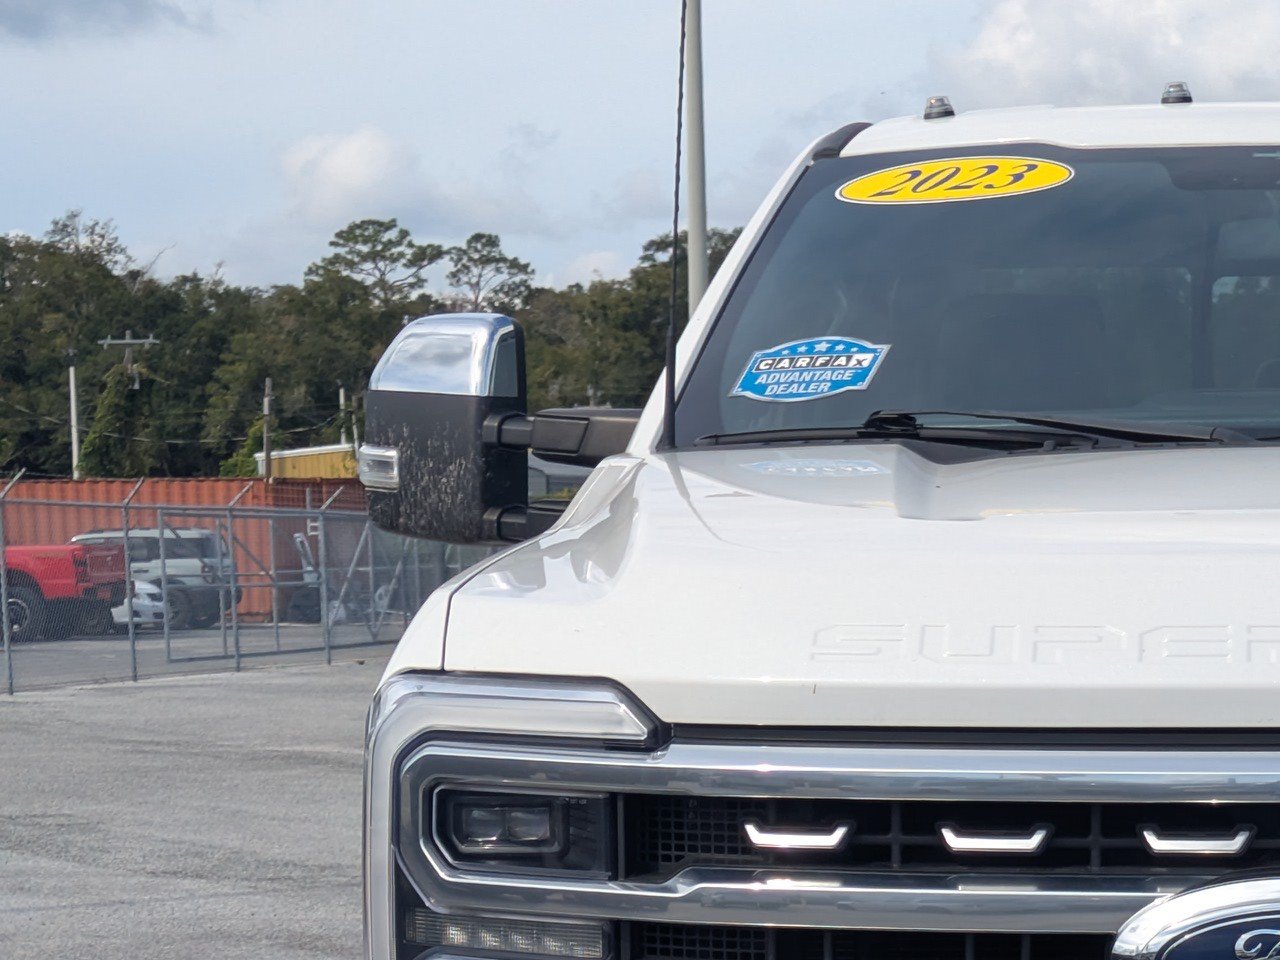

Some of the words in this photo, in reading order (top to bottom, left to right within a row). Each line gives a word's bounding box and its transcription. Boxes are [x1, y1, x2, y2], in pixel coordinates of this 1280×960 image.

[867, 164, 1038, 198] 2023
[757, 355, 871, 370] CARFAX
[754, 369, 854, 384] ADVANTAGE
[764, 382, 832, 395] DEALER
